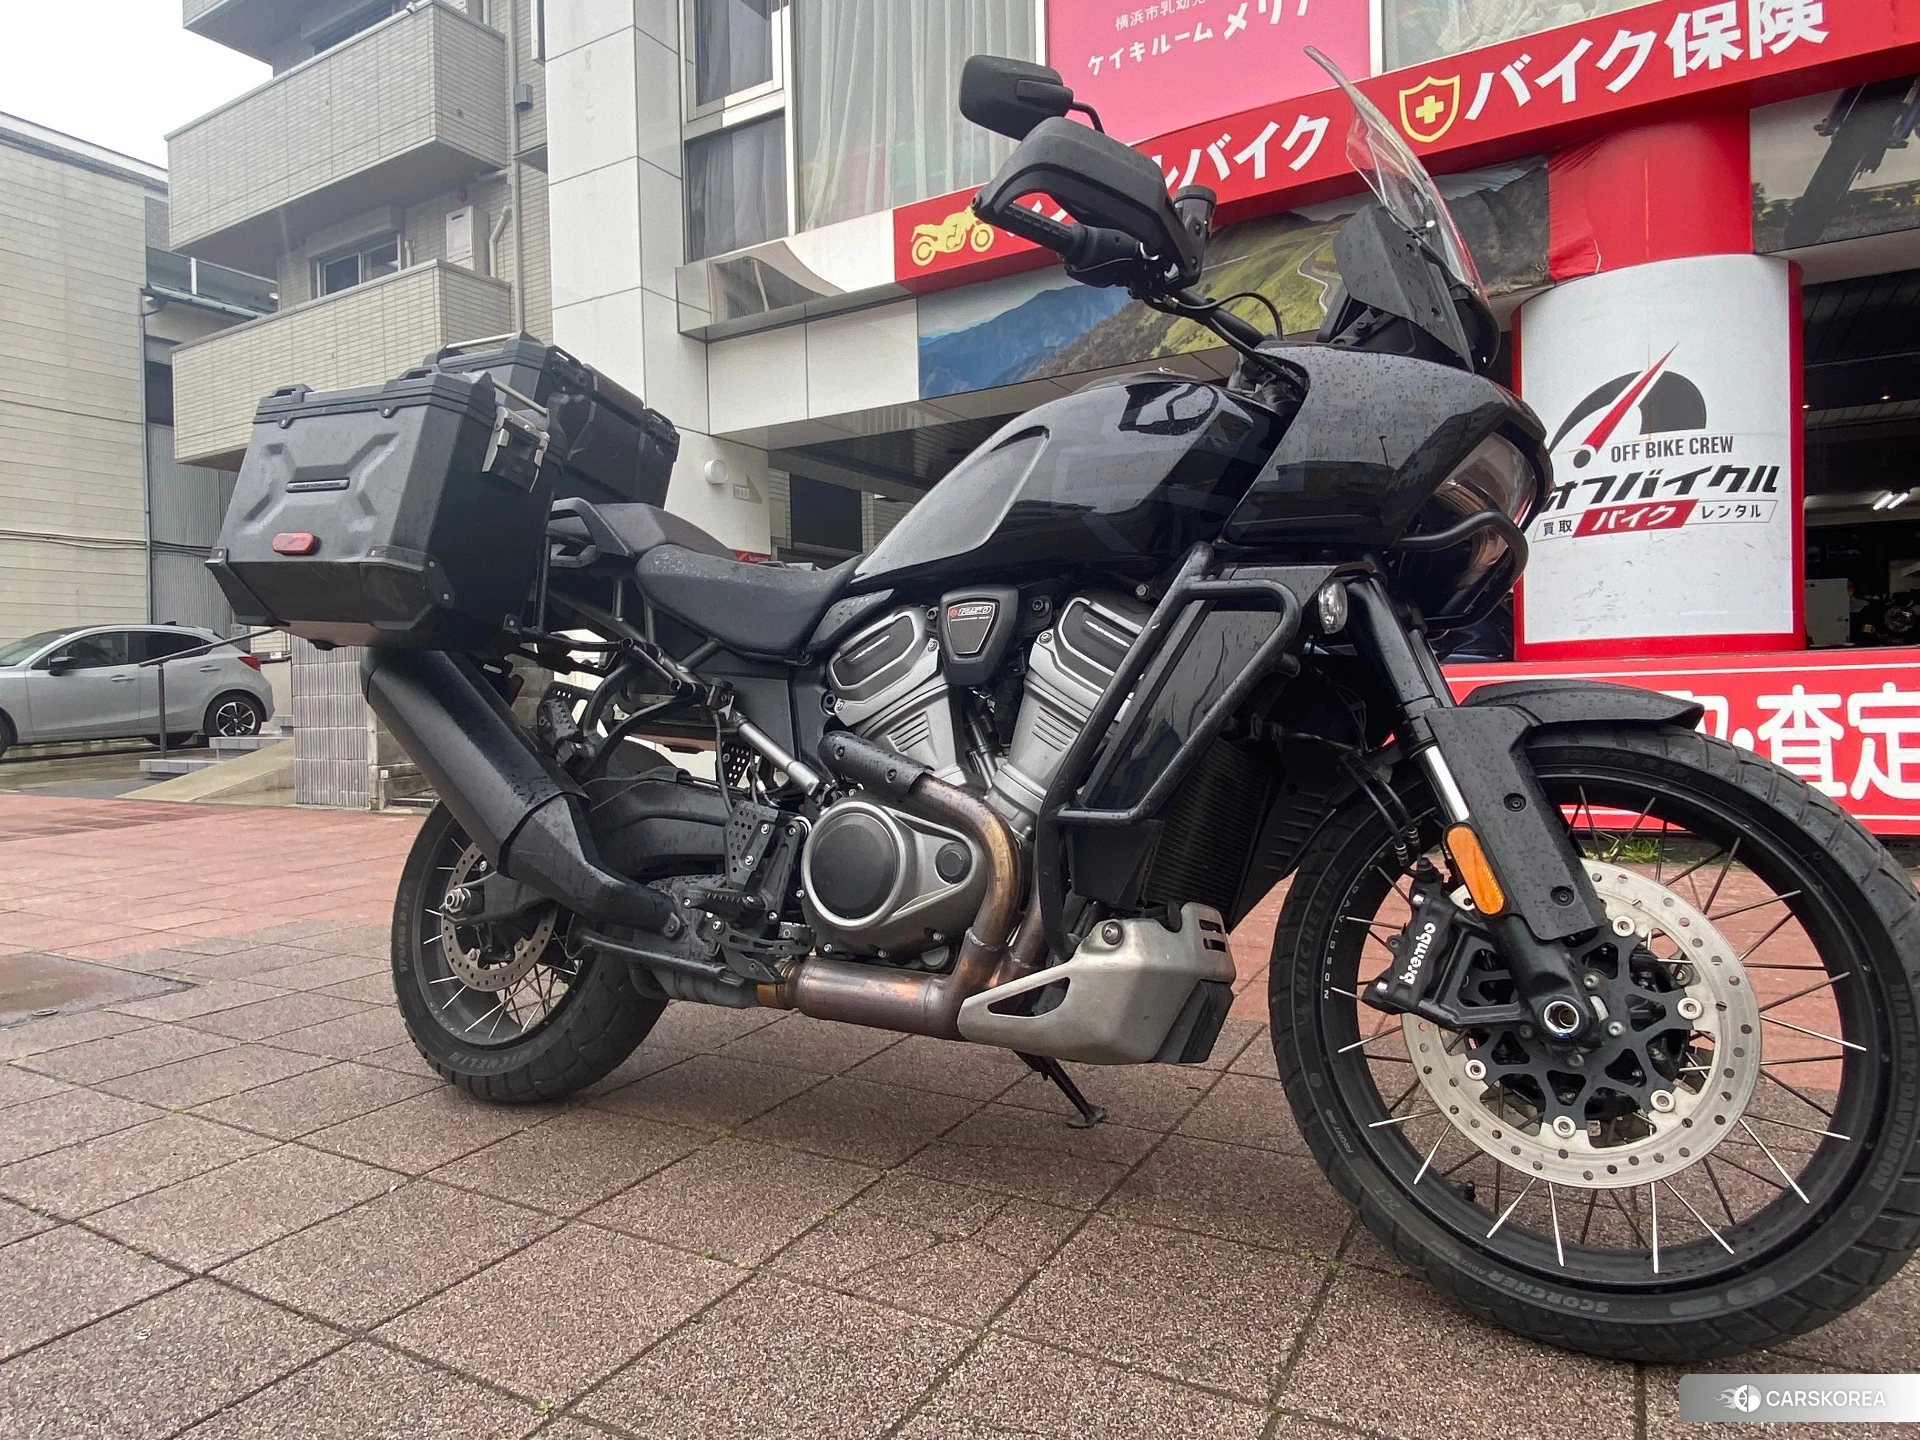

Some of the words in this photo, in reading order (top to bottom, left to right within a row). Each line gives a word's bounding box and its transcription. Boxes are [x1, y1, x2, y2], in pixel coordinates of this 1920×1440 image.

[1087, 22, 1215, 76] ケイキルーム
[1463, 0, 1829, 121] バイク保険
[1611, 443, 1642, 463] OFF
[1645, 438, 1684, 459] BIKE
[1689, 436, 1734, 455] CREW
[1543, 519, 1573, 537] 買取
[1590, 505, 1677, 532] バイク
[1701, 503, 1762, 520] レンタル
[1399, 922, 1436, 985] brembo
[1489, 1272, 1610, 1314] SCORCHER
